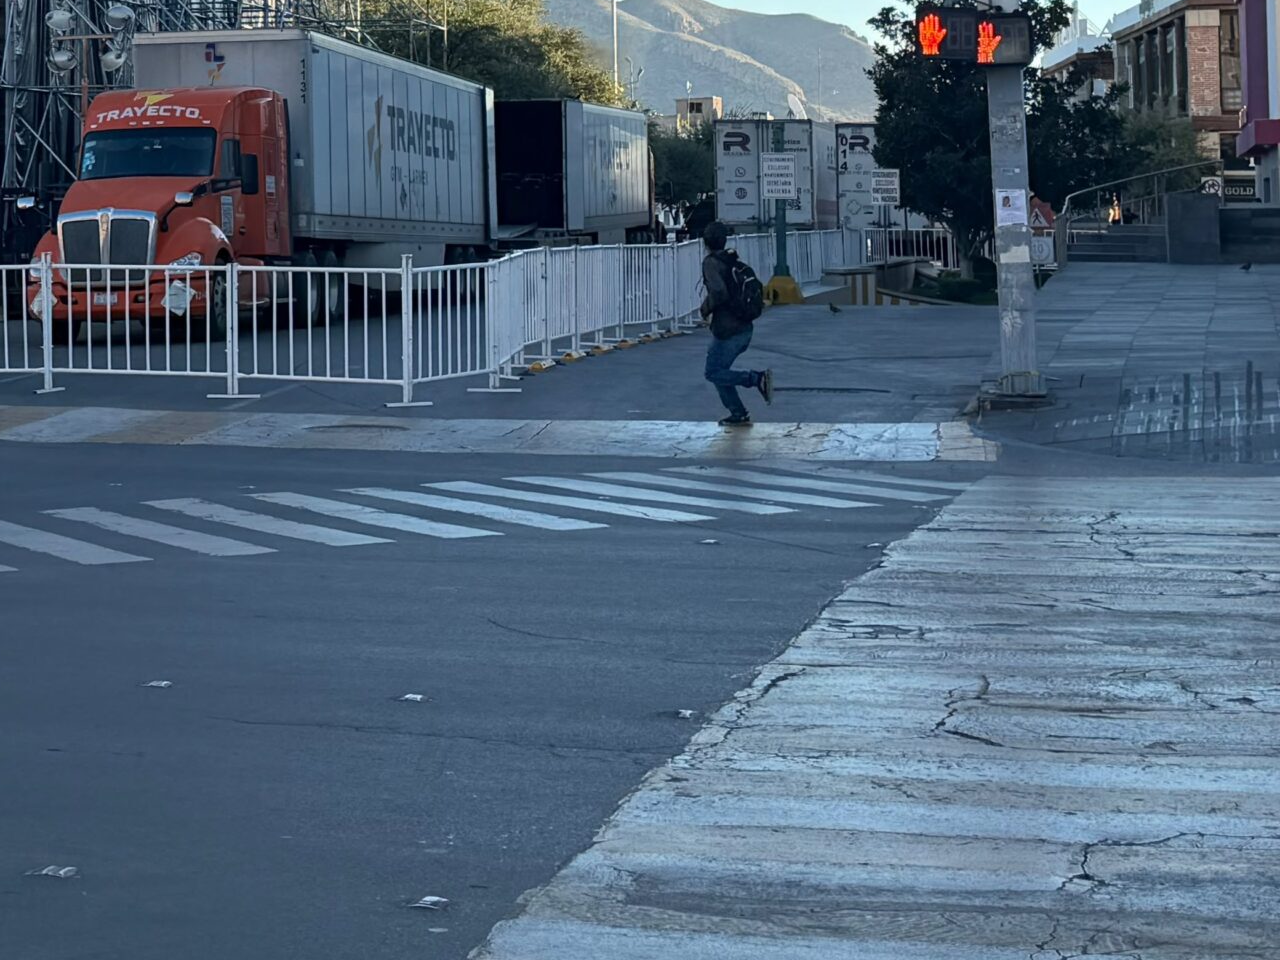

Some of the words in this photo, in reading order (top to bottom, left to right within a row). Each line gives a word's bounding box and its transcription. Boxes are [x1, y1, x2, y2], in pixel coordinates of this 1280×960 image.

[96, 105, 200, 124] TRAYECTO
[386, 104, 456, 162] TRAYECTO
[1225, 187, 1253, 195] GOLD
